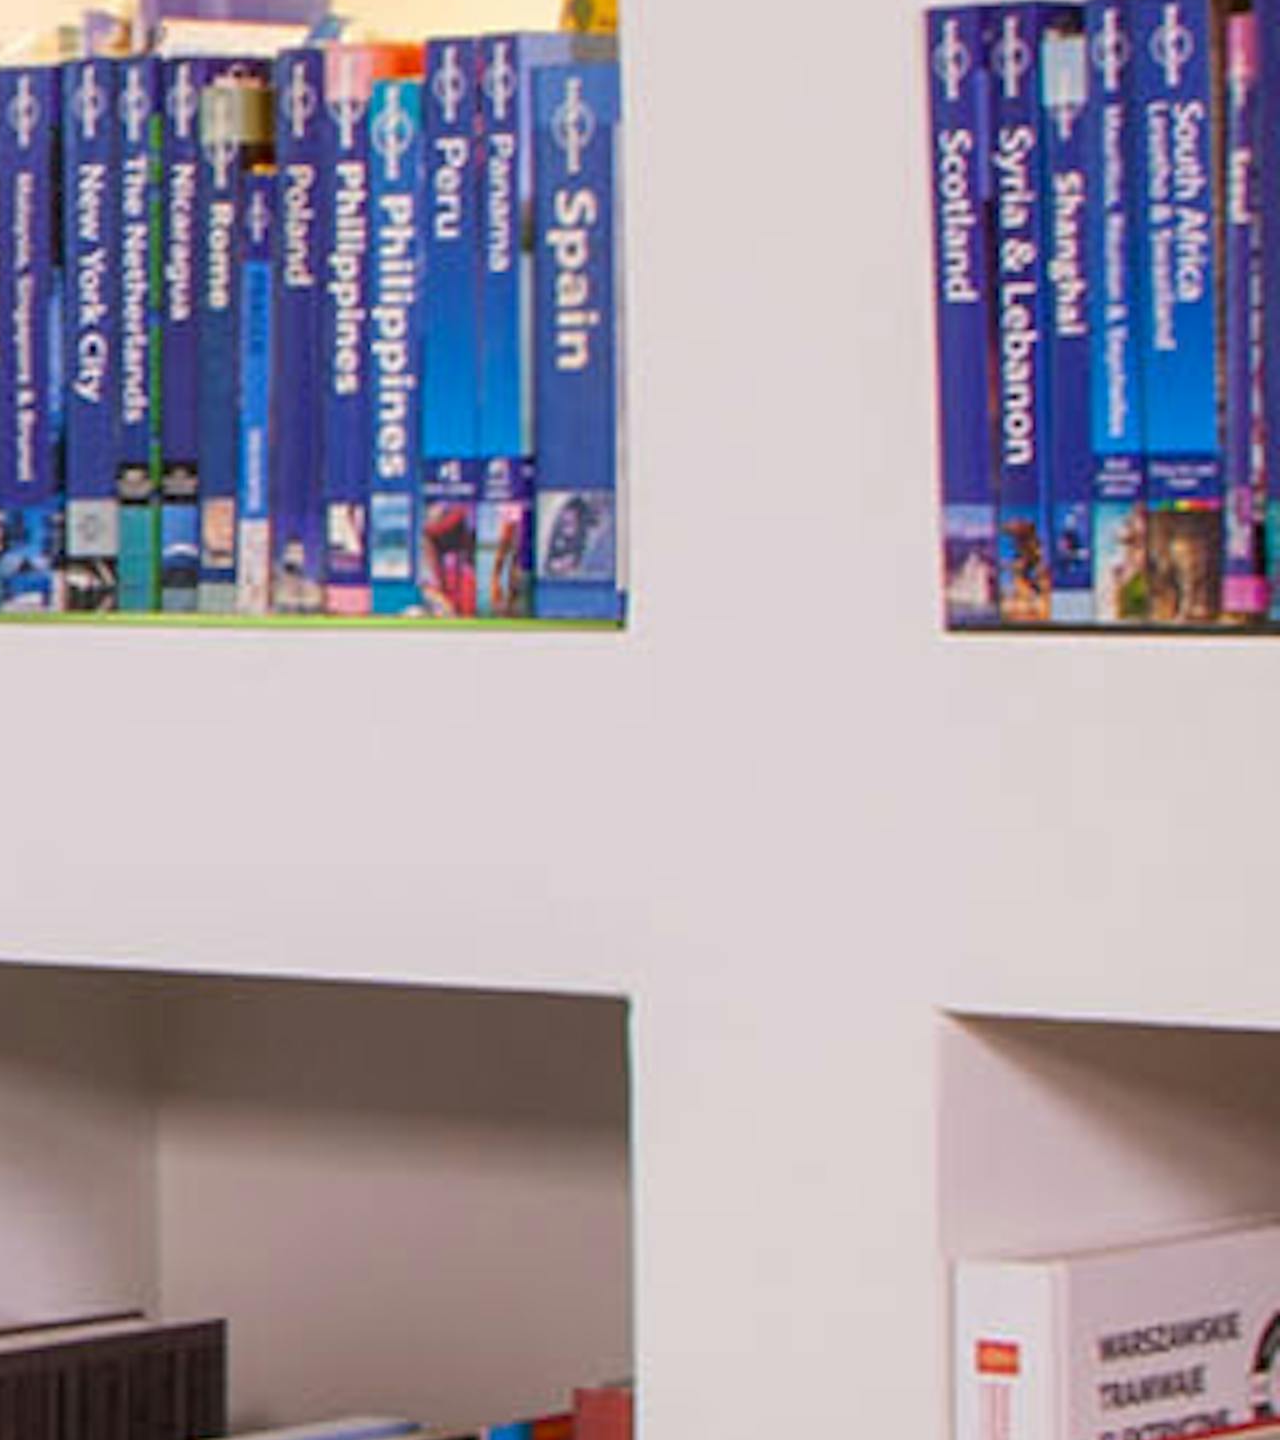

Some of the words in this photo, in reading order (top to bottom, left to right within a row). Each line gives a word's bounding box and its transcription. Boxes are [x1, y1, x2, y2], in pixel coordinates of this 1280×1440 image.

[79, 162, 105, 241] New
[123, 156, 148, 215] The
[435, 136, 468, 240] Peru
[488, 131, 514, 273] Panama
[995, 126, 1034, 229] Syria
[1171, 100, 1205, 200] South
[166, 162, 195, 320] Nicaragua
[209, 201, 233, 309] Rome
[284, 163, 314, 287] Poland
[939, 128, 977, 304] Scotland
[1002, 237, 1033, 269] &
[1049, 170, 1084, 336] Shanghai
[1174, 208, 1207, 302] Africa
[79, 249, 108, 329] York
[123, 224, 148, 424] Netherlands
[328, 162, 365, 395] Philippines
[371, 192, 415, 479] Philippines
[545, 187, 598, 372] Spain
[74, 333, 108, 402] City
[1002, 281, 1035, 465] Lebanon
